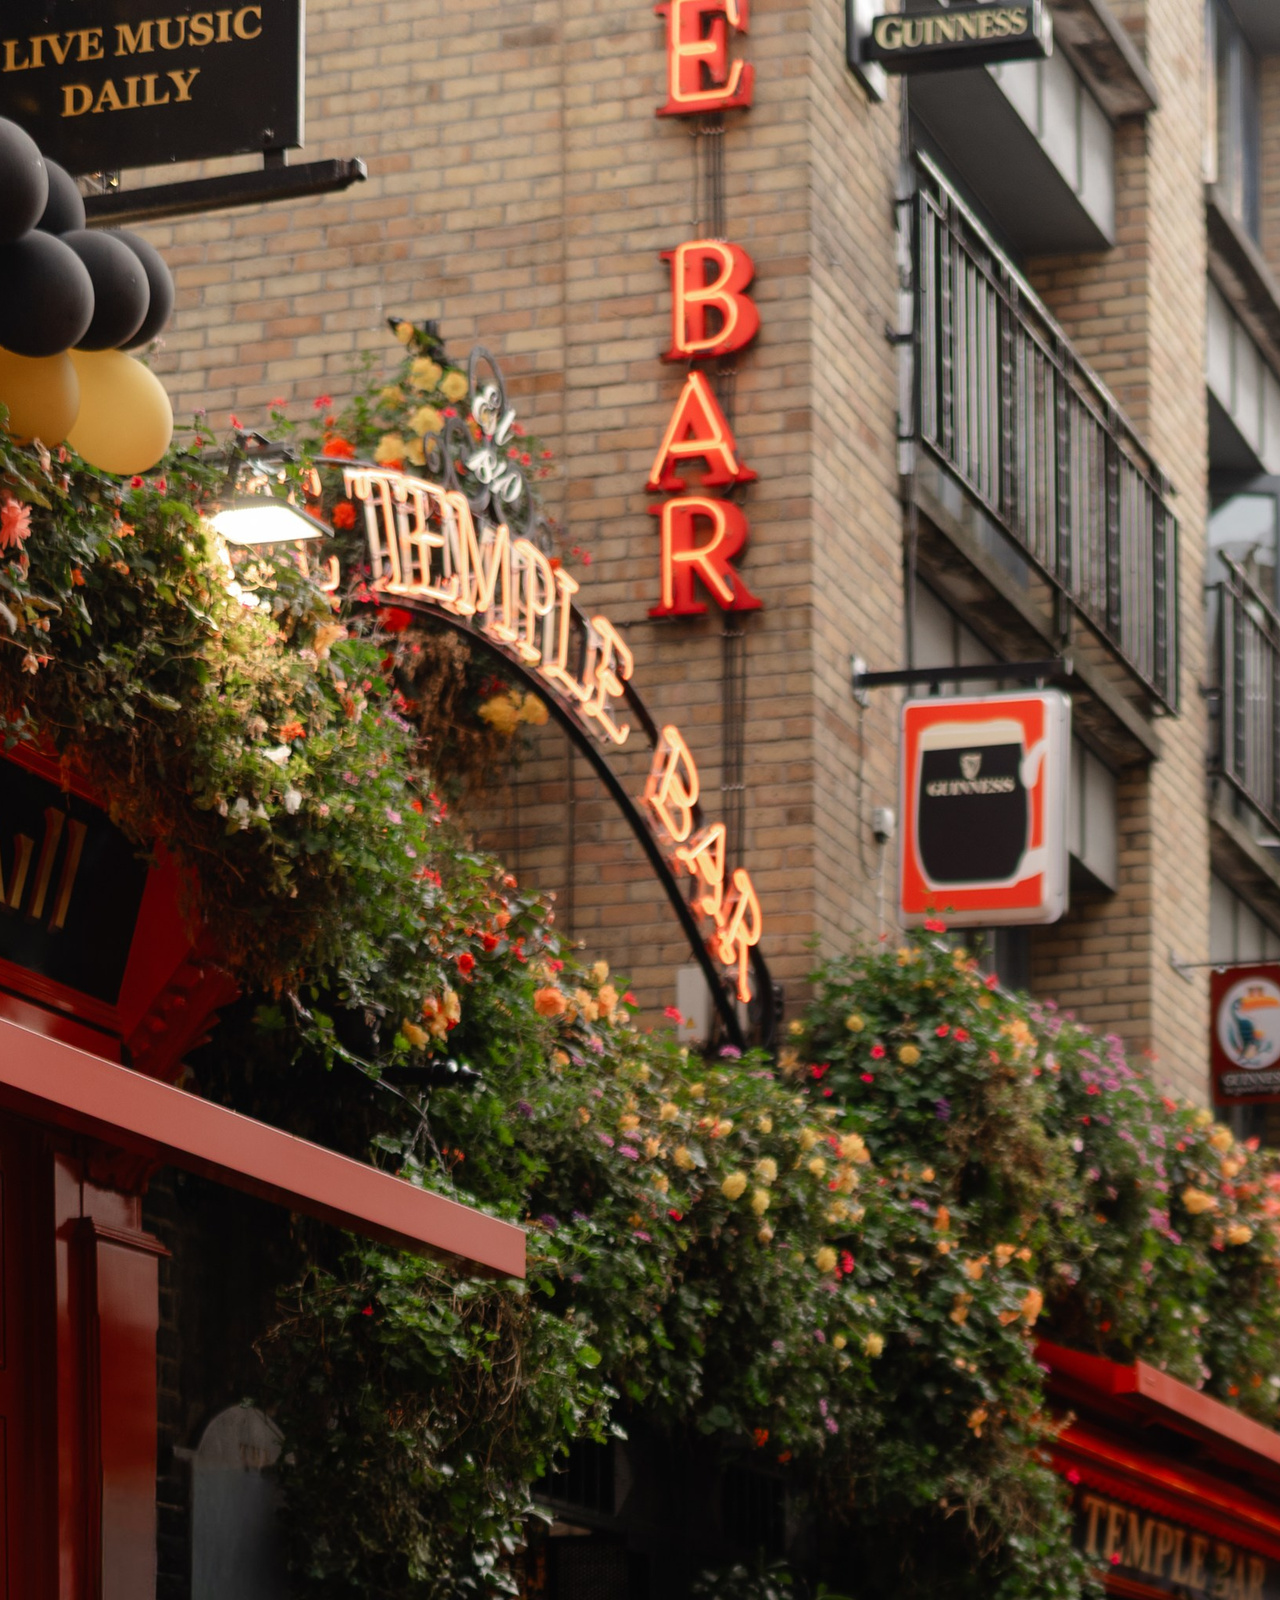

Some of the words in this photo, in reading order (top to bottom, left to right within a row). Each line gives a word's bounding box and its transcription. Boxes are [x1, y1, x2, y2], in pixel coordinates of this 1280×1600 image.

[2, 27, 104, 72] LIVE
[114, 6, 262, 56] MUSIC
[874, 7, 1028, 50] GUINNESS
[60, 67, 200, 117] DAILY
[645, 240, 762, 616] BAR
[343, 468, 634, 746] TEMPLE
[645, 724, 762, 1003] BAR
[926, 777, 1016, 797] GUINNESS
[1083, 1494, 1209, 1591] TEMPLE
